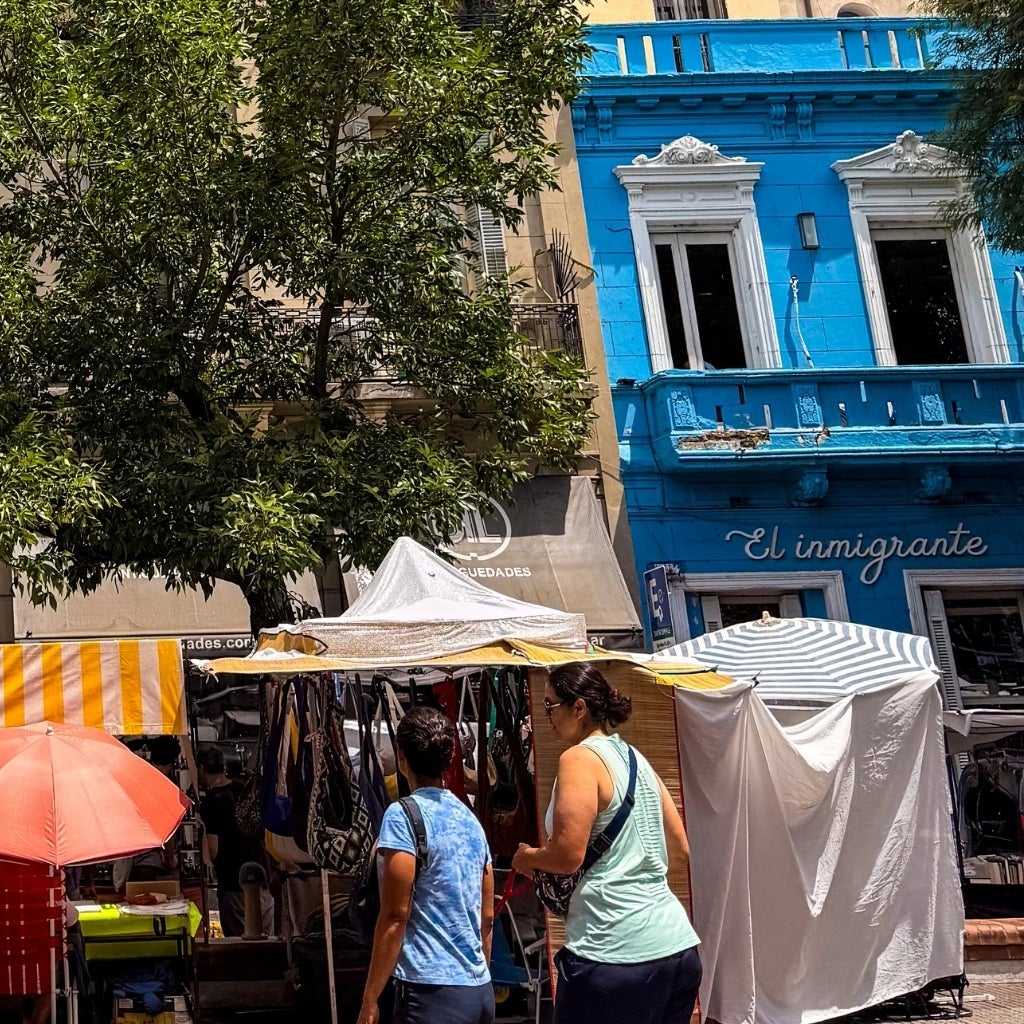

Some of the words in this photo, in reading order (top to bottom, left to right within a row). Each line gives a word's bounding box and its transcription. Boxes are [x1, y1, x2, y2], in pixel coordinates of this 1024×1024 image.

[459, 566, 532, 578] GUEDADES
[726, 525, 785, 560] El
[795, 522, 989, 585] inmigrante
